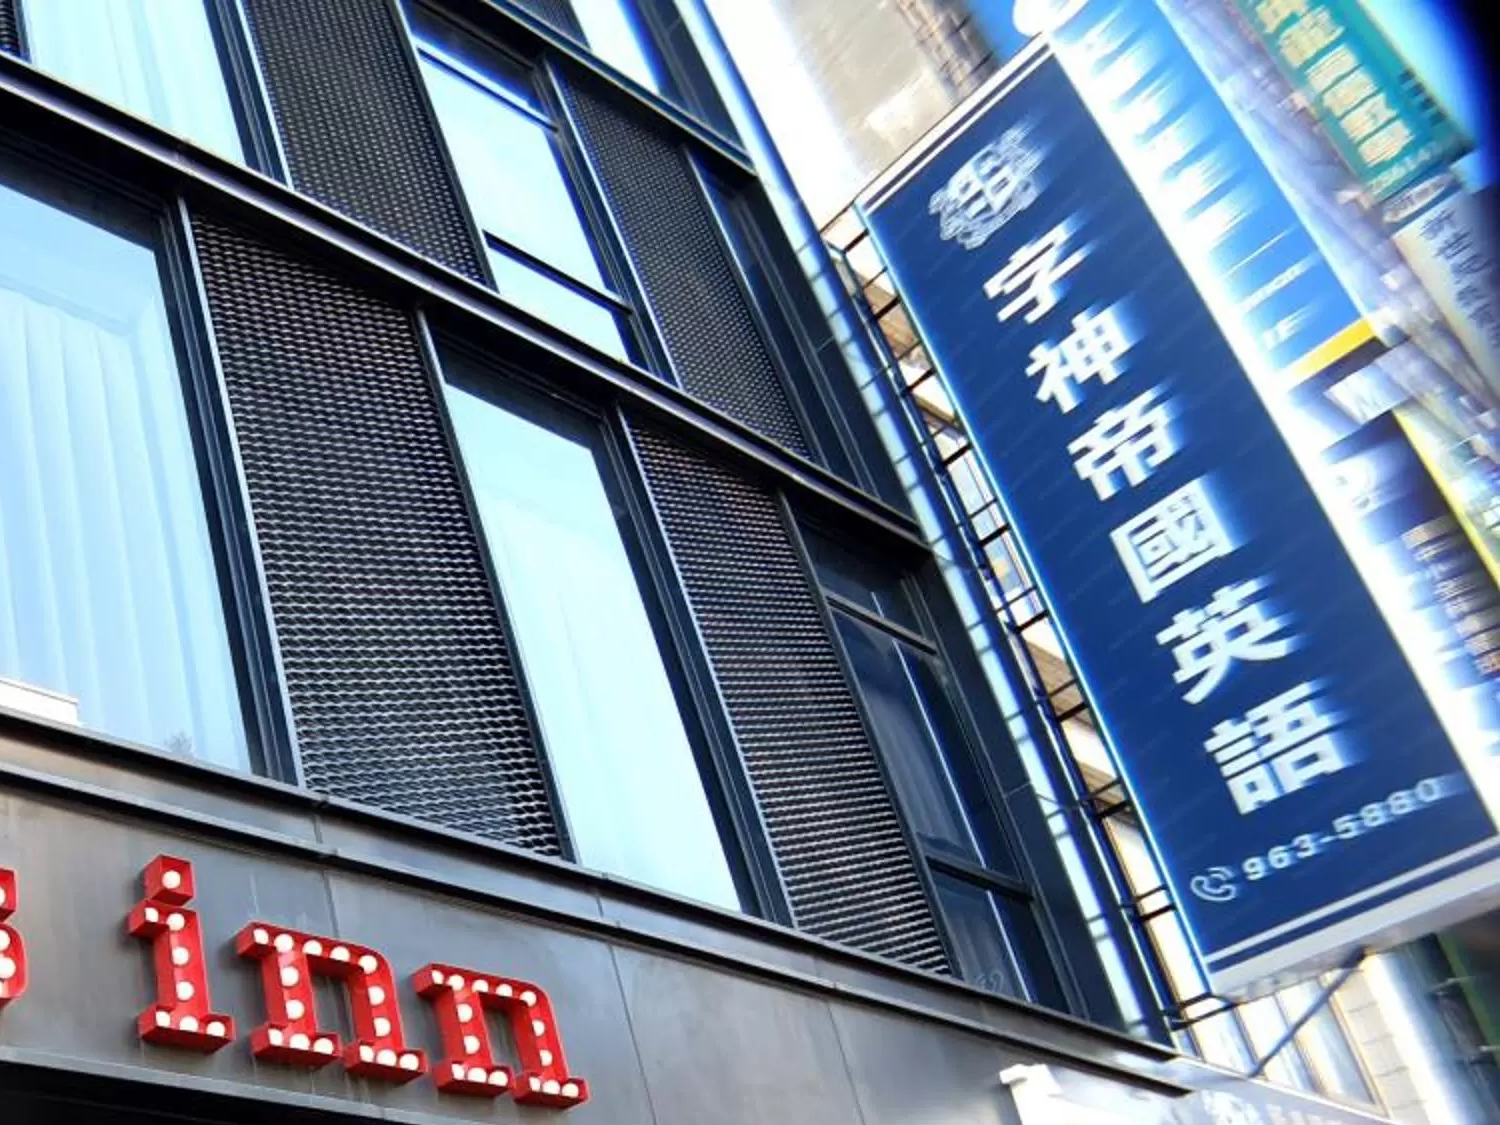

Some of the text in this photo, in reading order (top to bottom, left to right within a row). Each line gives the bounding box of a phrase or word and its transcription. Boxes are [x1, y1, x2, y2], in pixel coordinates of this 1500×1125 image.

[983, 209, 1353, 815] 字神帝國英語
[1242, 777, 1443, 881] 963-5880
[127, 854, 590, 1109] inn
